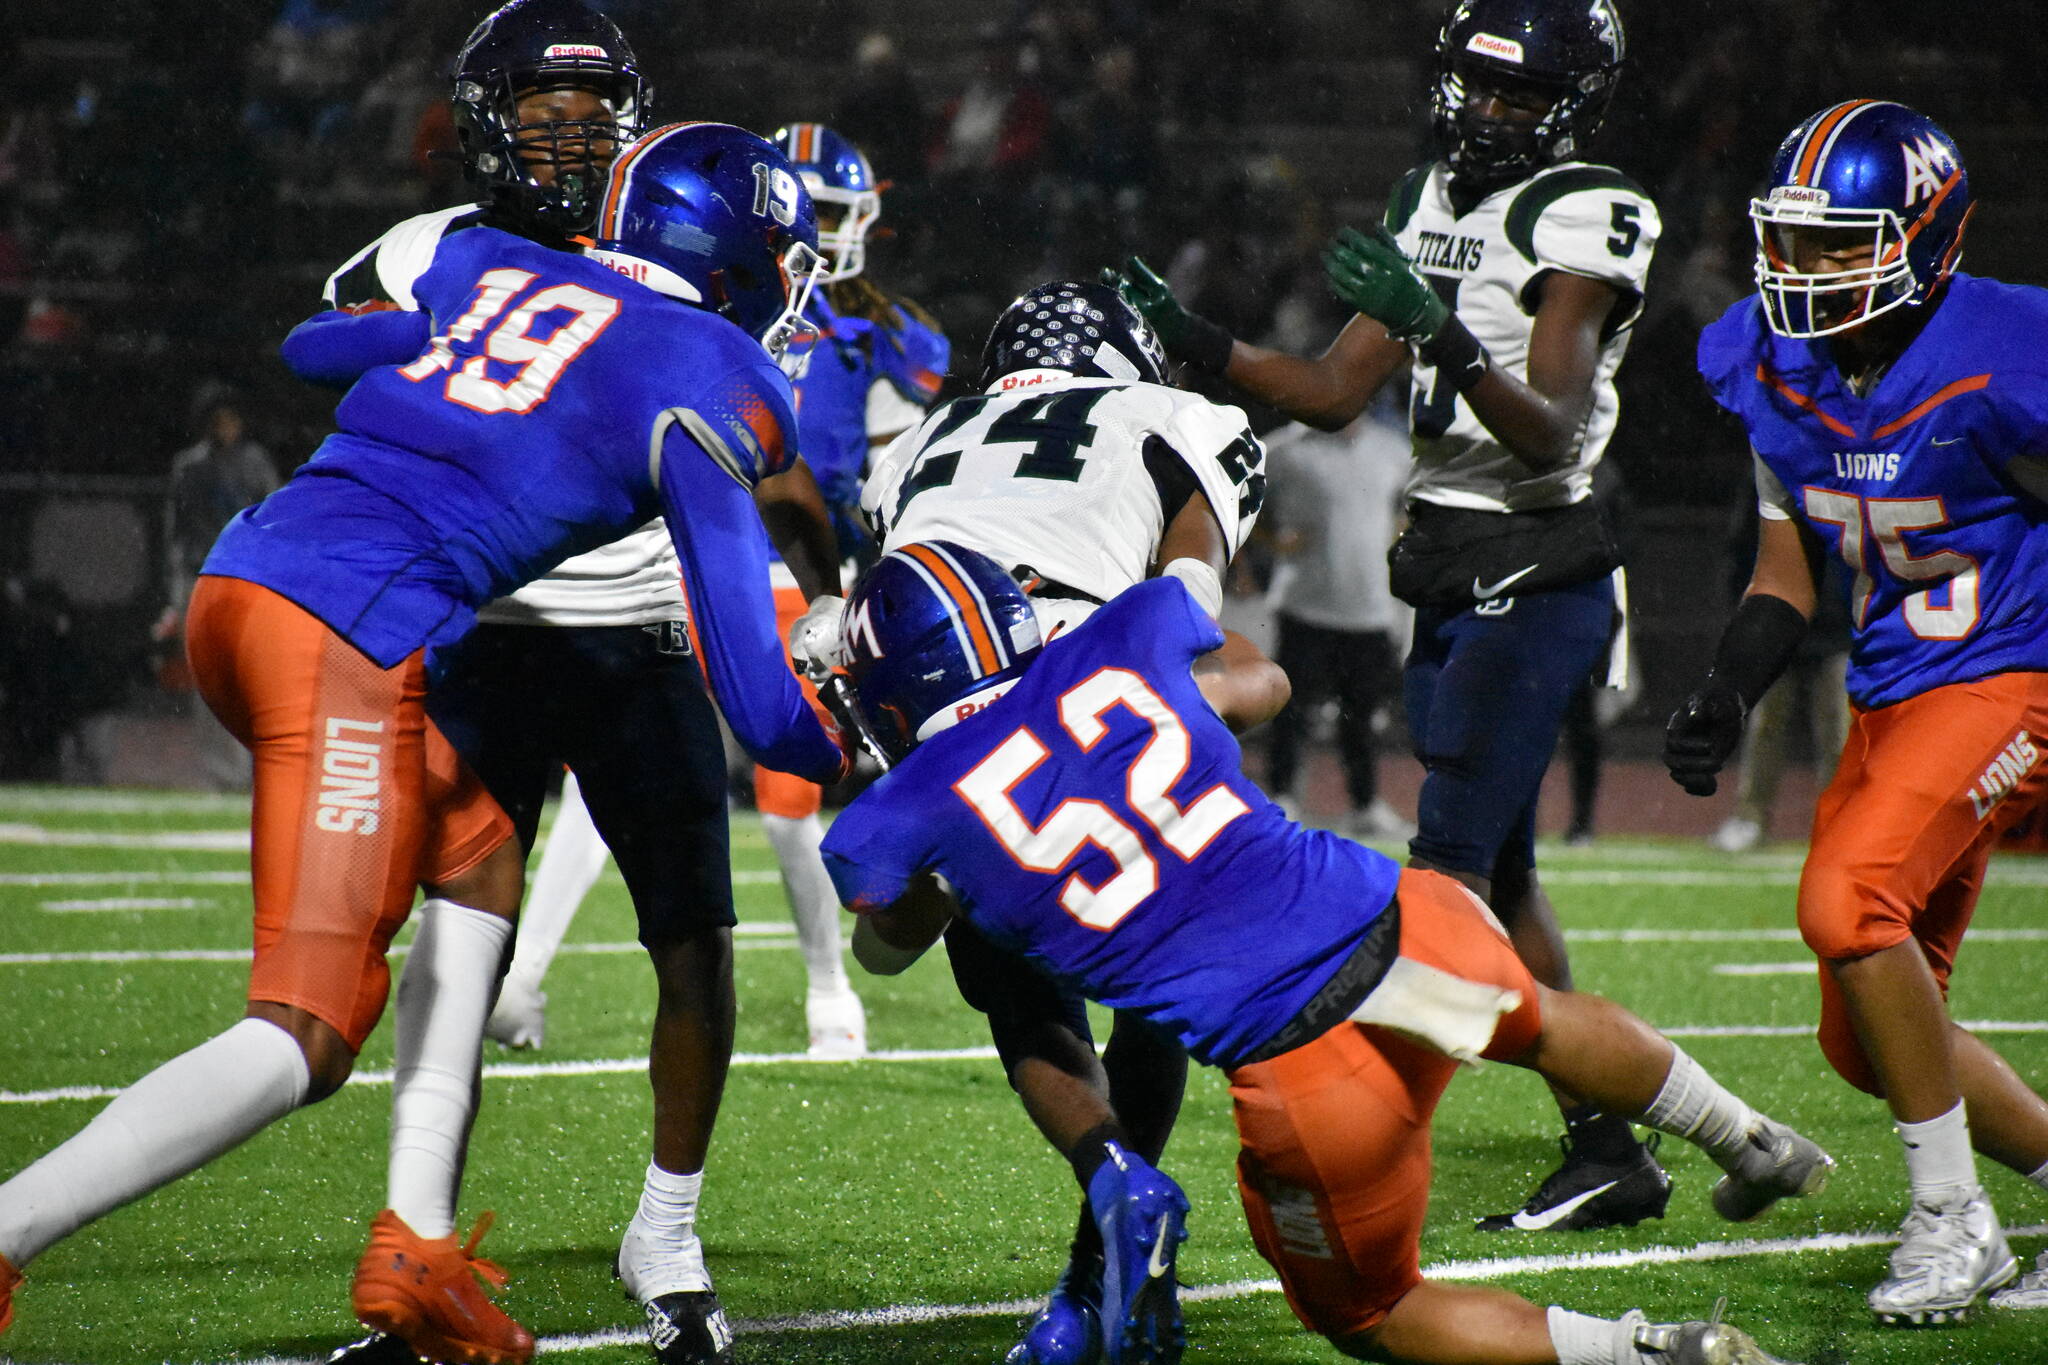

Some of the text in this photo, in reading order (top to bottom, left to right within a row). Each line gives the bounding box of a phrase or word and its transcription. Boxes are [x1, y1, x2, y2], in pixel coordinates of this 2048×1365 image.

[552, 46, 601, 57] Riddell
[1475, 36, 1516, 55] Riddell
[752, 162, 800, 227] 19
[1606, 202, 1641, 259] 5
[1416, 230, 1485, 272] TITANS
[397, 267, 623, 415] 19
[891, 385, 1131, 532] 24
[1833, 453, 1901, 481] LIONS
[1803, 485, 1981, 642] 75
[315, 717, 384, 836] LIONS
[951, 666, 1252, 932] 52
[1966, 730, 2039, 822] LIONS
